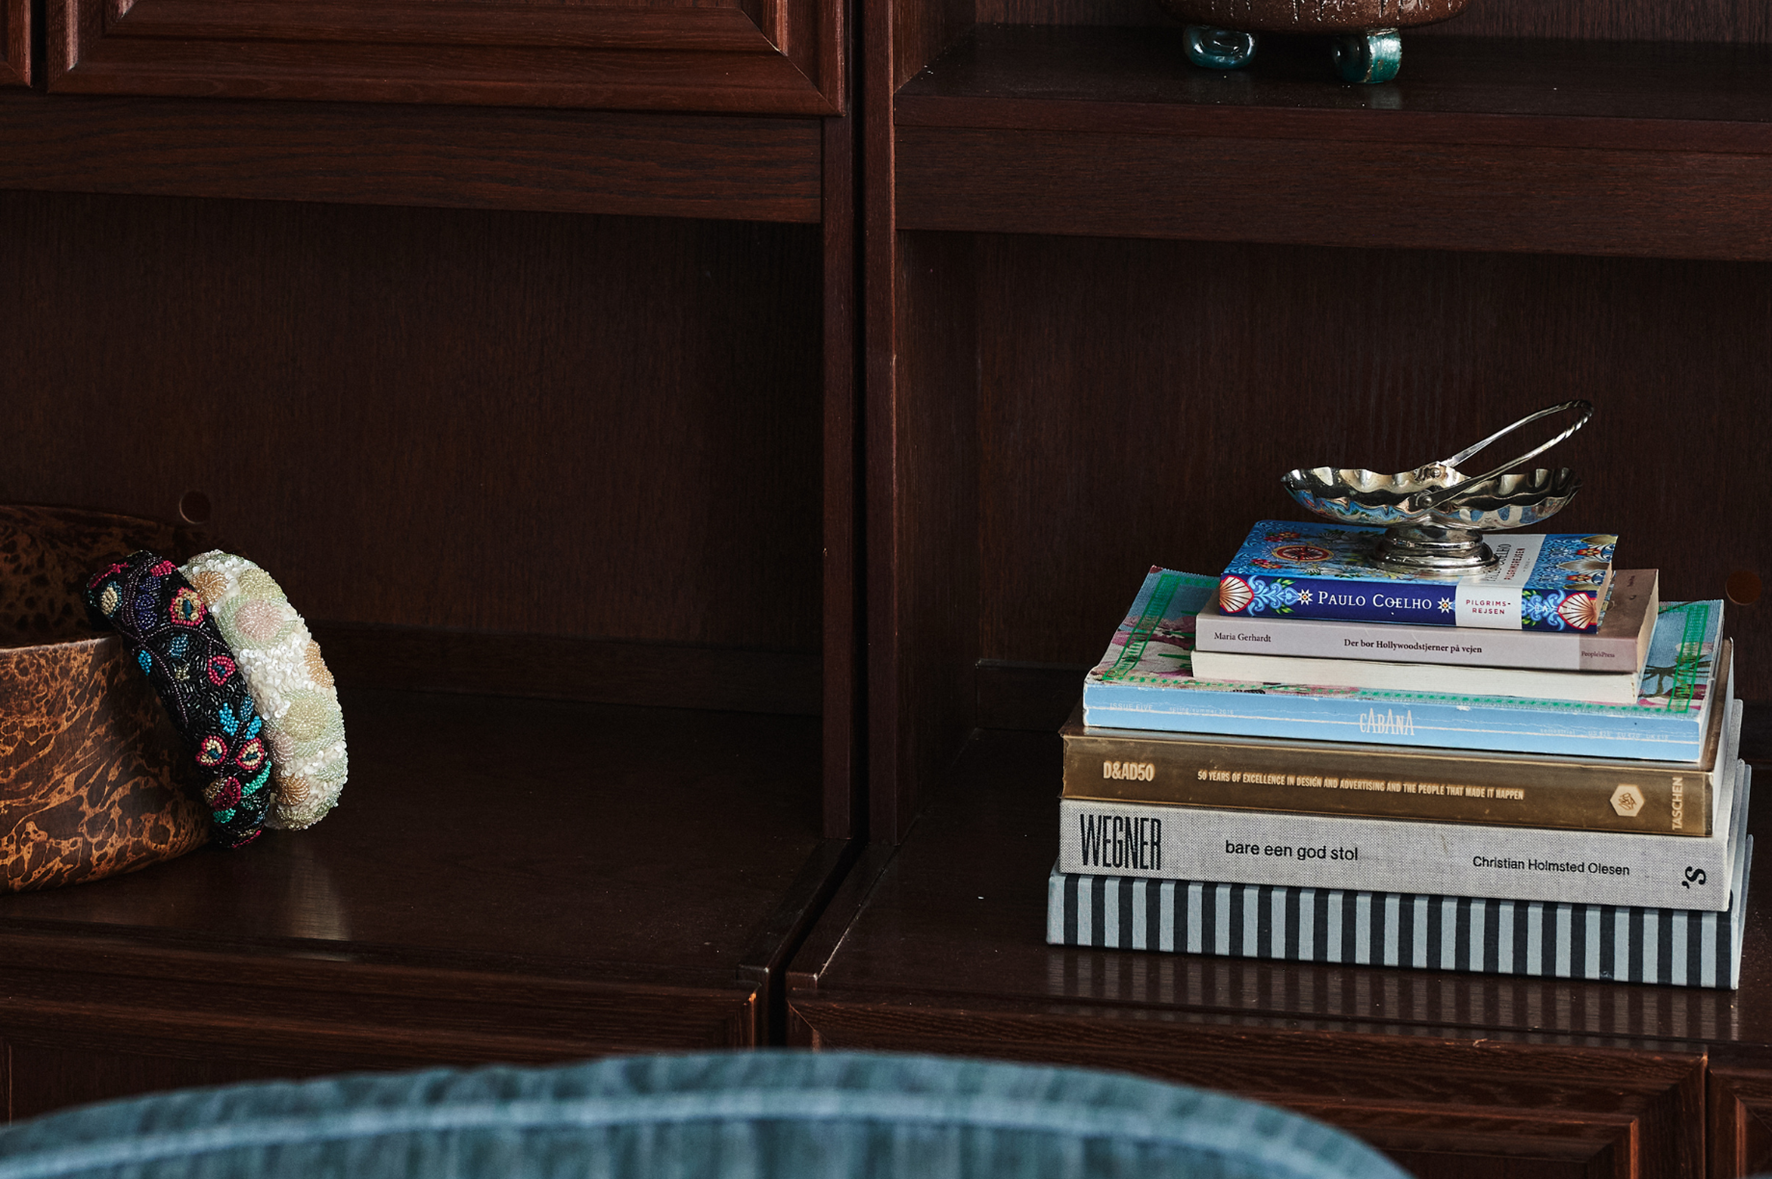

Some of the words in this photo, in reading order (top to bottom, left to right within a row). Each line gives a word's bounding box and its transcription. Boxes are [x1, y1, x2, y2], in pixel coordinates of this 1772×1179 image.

[1318, 591, 1366, 607] PAULO
[1372, 594, 1432, 610] COELHO
[1465, 599, 1511, 607] PILGRIMS-
[1472, 607, 1505, 615] REJSEN
[1214, 632, 1236, 641] Maria
[1237, 633, 1271, 643] Gerhardt
[1344, 639, 1359, 647] Der
[1360, 639, 1374, 648] bor
[1376, 640, 1449, 653] Hollywoodstjerner
[1450, 643, 1460, 654] på
[1461, 645, 1482, 654] vejen
[1359, 708, 1415, 735] CABANA
[1103, 760, 1156, 782] D&AD50
[1197, 769, 1207, 781] 50
[1208, 770, 1230, 782] YEARS
[1232, 771, 1241, 782] OF
[1243, 772, 1285, 785] EXCELLENCE
[1286, 774, 1295, 786] IN
[1296, 775, 1322, 788] DESIGN
[1323, 777, 1339, 788] AND
[1340, 777, 1385, 791] ADVERTISING
[1386, 780, 1401, 792] AND
[1403, 781, 1417, 794] THE
[1418, 782, 1445, 795] PEOPLE
[1446, 784, 1465, 797] THAT
[1465, 785, 1485, 798] MADE
[1486, 787, 1495, 798] IT
[1495, 786, 1524, 800] HAPPEN
[1671, 776, 1683, 831] TASCHEN
[1080, 814, 1162, 871] WEGNER
[1225, 840, 1260, 855] bare
[1263, 843, 1292, 857] een
[1296, 845, 1327, 861] god
[1330, 847, 1359, 861] stol
[1472, 856, 1525, 870] Christian
[1528, 859, 1585, 873] Holmsted
[1587, 862, 1630, 876] Olesen
